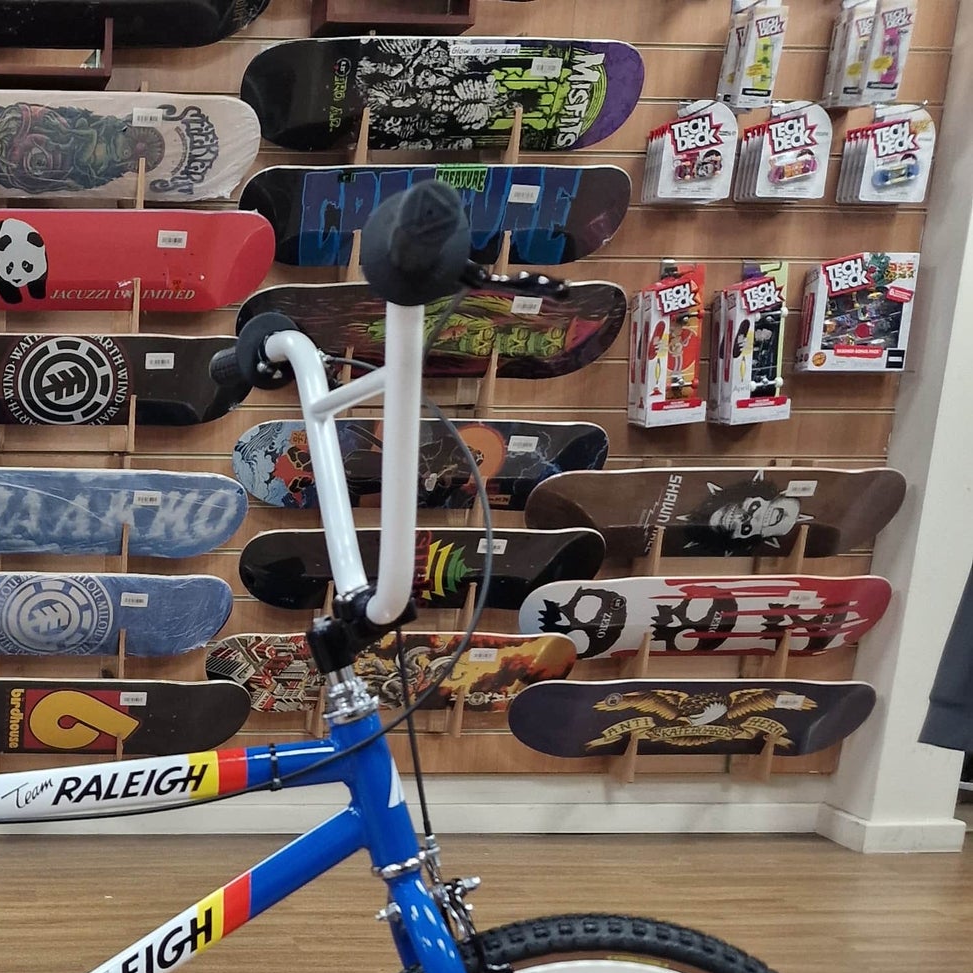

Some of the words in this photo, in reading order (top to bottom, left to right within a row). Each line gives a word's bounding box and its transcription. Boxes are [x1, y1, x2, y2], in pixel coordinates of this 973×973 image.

[758, 17, 780, 29] TECH
[452, 46, 468, 55] Glow
[472, 46, 481, 54] in
[487, 46, 498, 54] the
[502, 46, 519, 54] dark
[556, 53, 606, 147] MISFITS
[671, 116, 710, 138] TECH
[769, 117, 805, 139] TECH
[874, 122, 910, 143] TECH
[675, 129, 719, 152] DECK
[774, 130, 813, 153] DECK
[879, 134, 917, 156] DECK
[436, 168, 488, 192] CREATURE
[826, 258, 863, 278] TECH
[659, 283, 691, 302] TECH
[744, 280, 776, 301] TECH
[831, 271, 869, 292] DECK
[49, 289, 111, 300] JACUZZI
[113, 289, 197, 300] UNIMITED
[663, 292, 698, 313] DECK
[747, 291, 787, 312] DECK
[90, 335, 125, 367] ARTH
[2, 364, 17, 399] WIND
[116, 367, 129, 402] WIND
[7, 402, 44, 426] ARTH
[656, 474, 683, 523] SHAWN
[95, 600, 109, 638] MILOU
[596, 611, 614, 639] ZERO
[8, 688, 25, 749] birdhouse
[606, 717, 651, 737] ANTI
[1, 778, 54, 809] Team
[51, 764, 209, 806] RALEIGH
